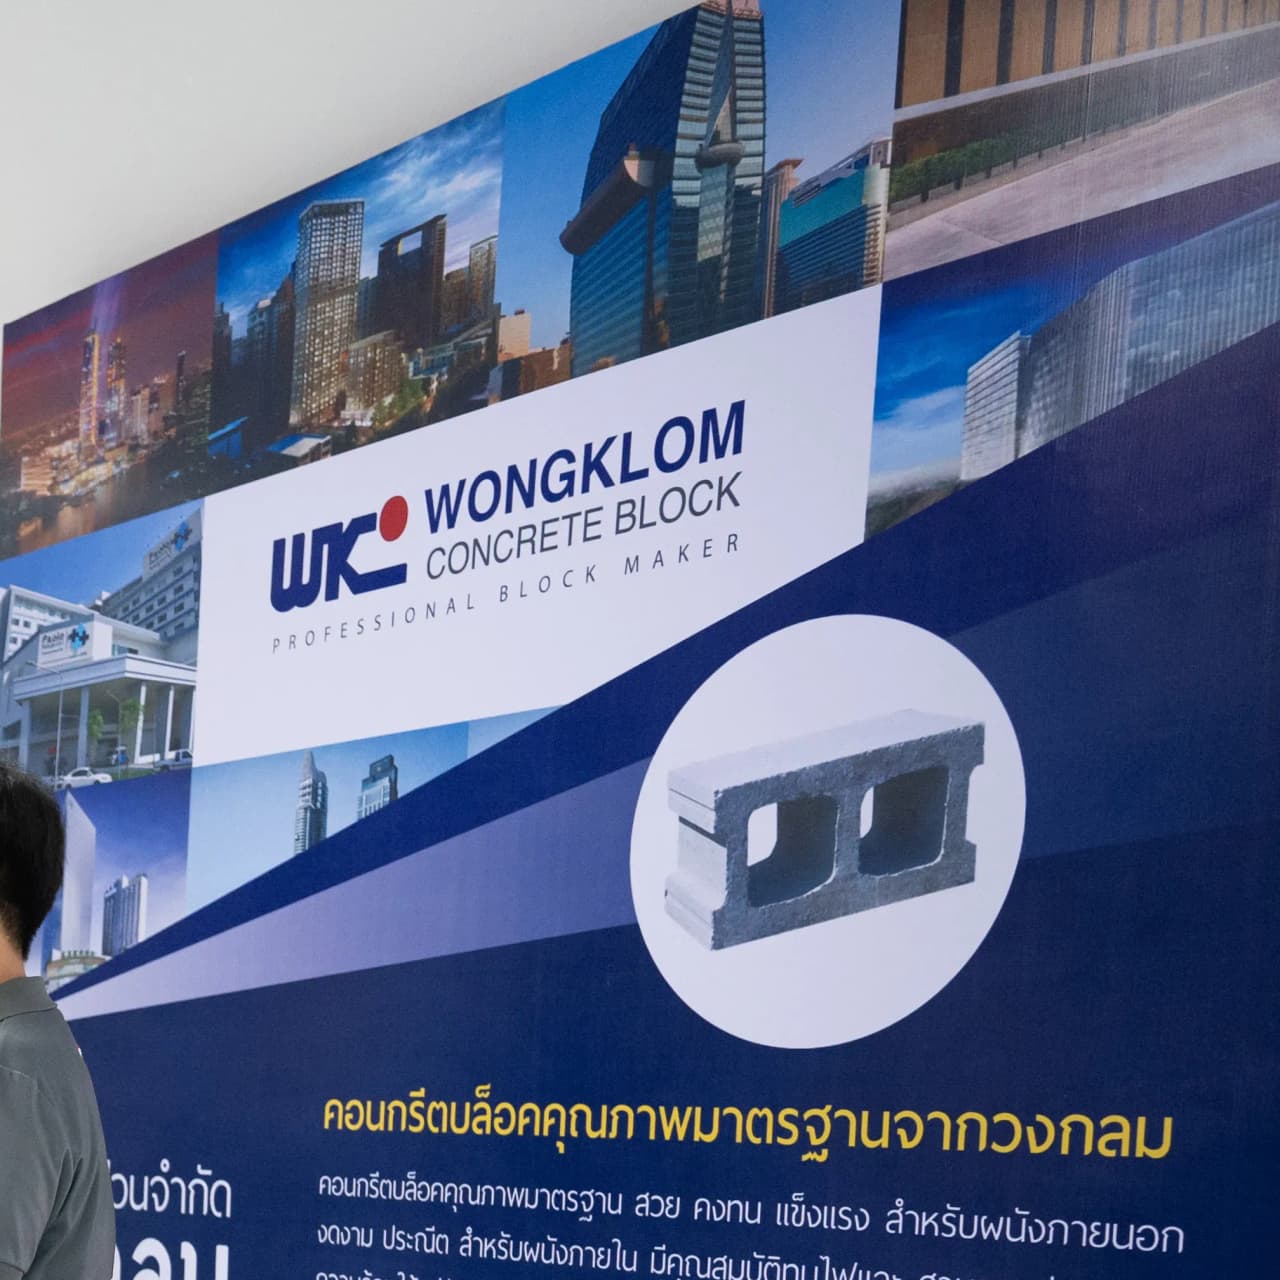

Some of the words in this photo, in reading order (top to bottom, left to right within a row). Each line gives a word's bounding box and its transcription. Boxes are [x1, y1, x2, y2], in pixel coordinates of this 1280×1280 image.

[424, 400, 745, 534] WONGKLOM
[426, 505, 602, 580] CONCRETE
[614, 471, 744, 536] BLOCK
[272, 593, 476, 654] PROFESSIONAL
[499, 564, 598, 603] BLOCK
[624, 533, 739, 575] MAKER
[323, 1083, 1173, 1163] คอนกรีตบล็อคคุณภาพมาตรฐานจากวงกลม
[318, 1225, 373, 1247] งดงาม
[383, 1225, 448, 1254] ประณีต
[460, 1227, 637, 1271] สำหรับผนังภายใน
[320, 1172, 622, 1221] คอนกรีตบล็อคคุณภาพมาตรฐาน
[635, 1193, 680, 1218] สวย
[694, 1198, 761, 1224] คงทน
[777, 1193, 869, 1231] แข็งแรง
[886, 1198, 1183, 1252] สำหรับผนังภายนอก
